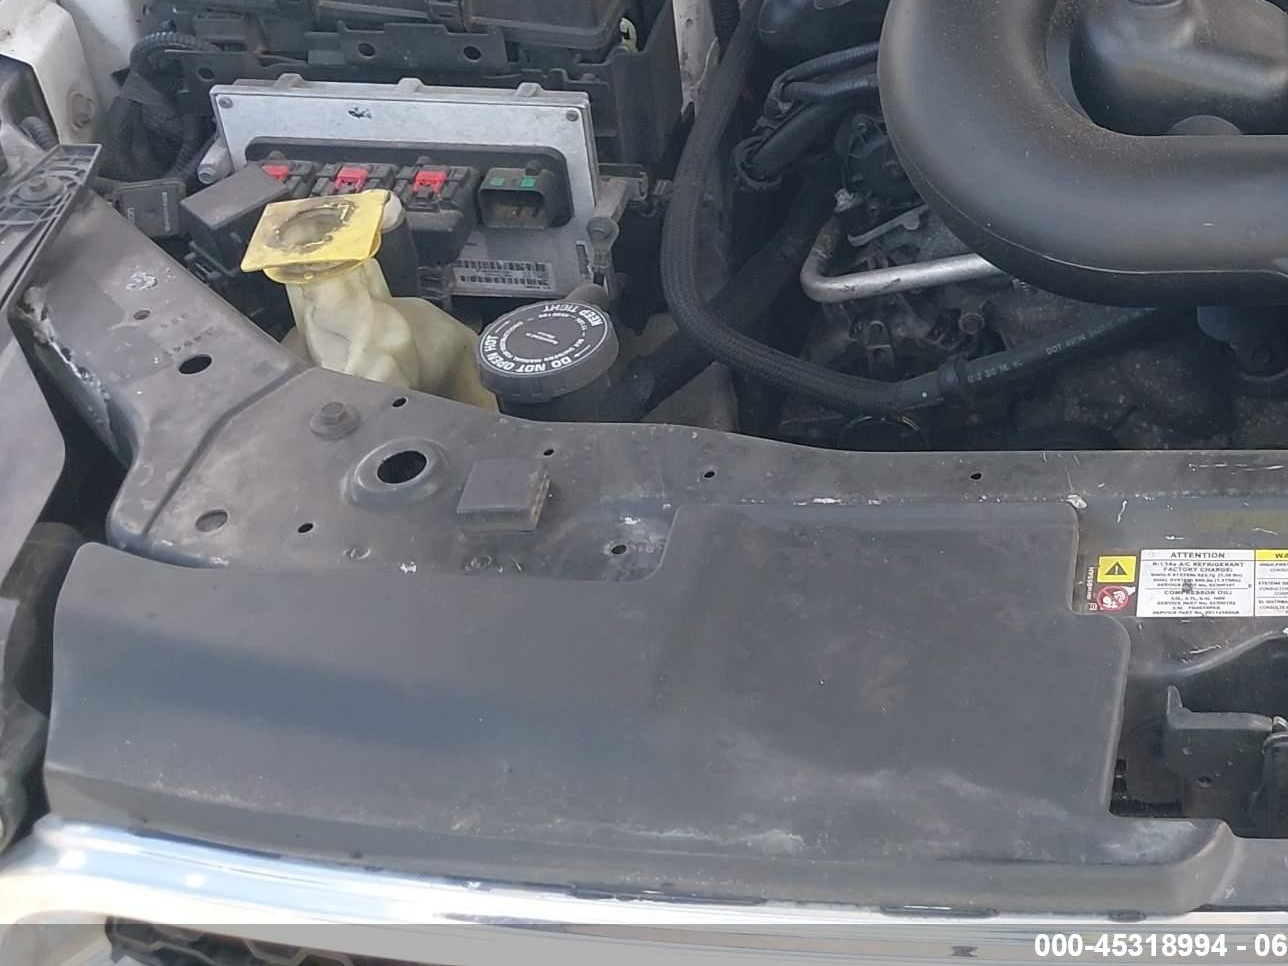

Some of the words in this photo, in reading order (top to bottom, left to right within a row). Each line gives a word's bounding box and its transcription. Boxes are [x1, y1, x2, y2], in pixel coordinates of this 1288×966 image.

[542, 303, 581, 313] TIGHT
[578, 308, 604, 328] KEEP
[483, 334, 499, 353] HOT
[485, 352, 516, 371] OPEN
[515, 362, 547, 374] NOT
[550, 357, 573, 370] DO
